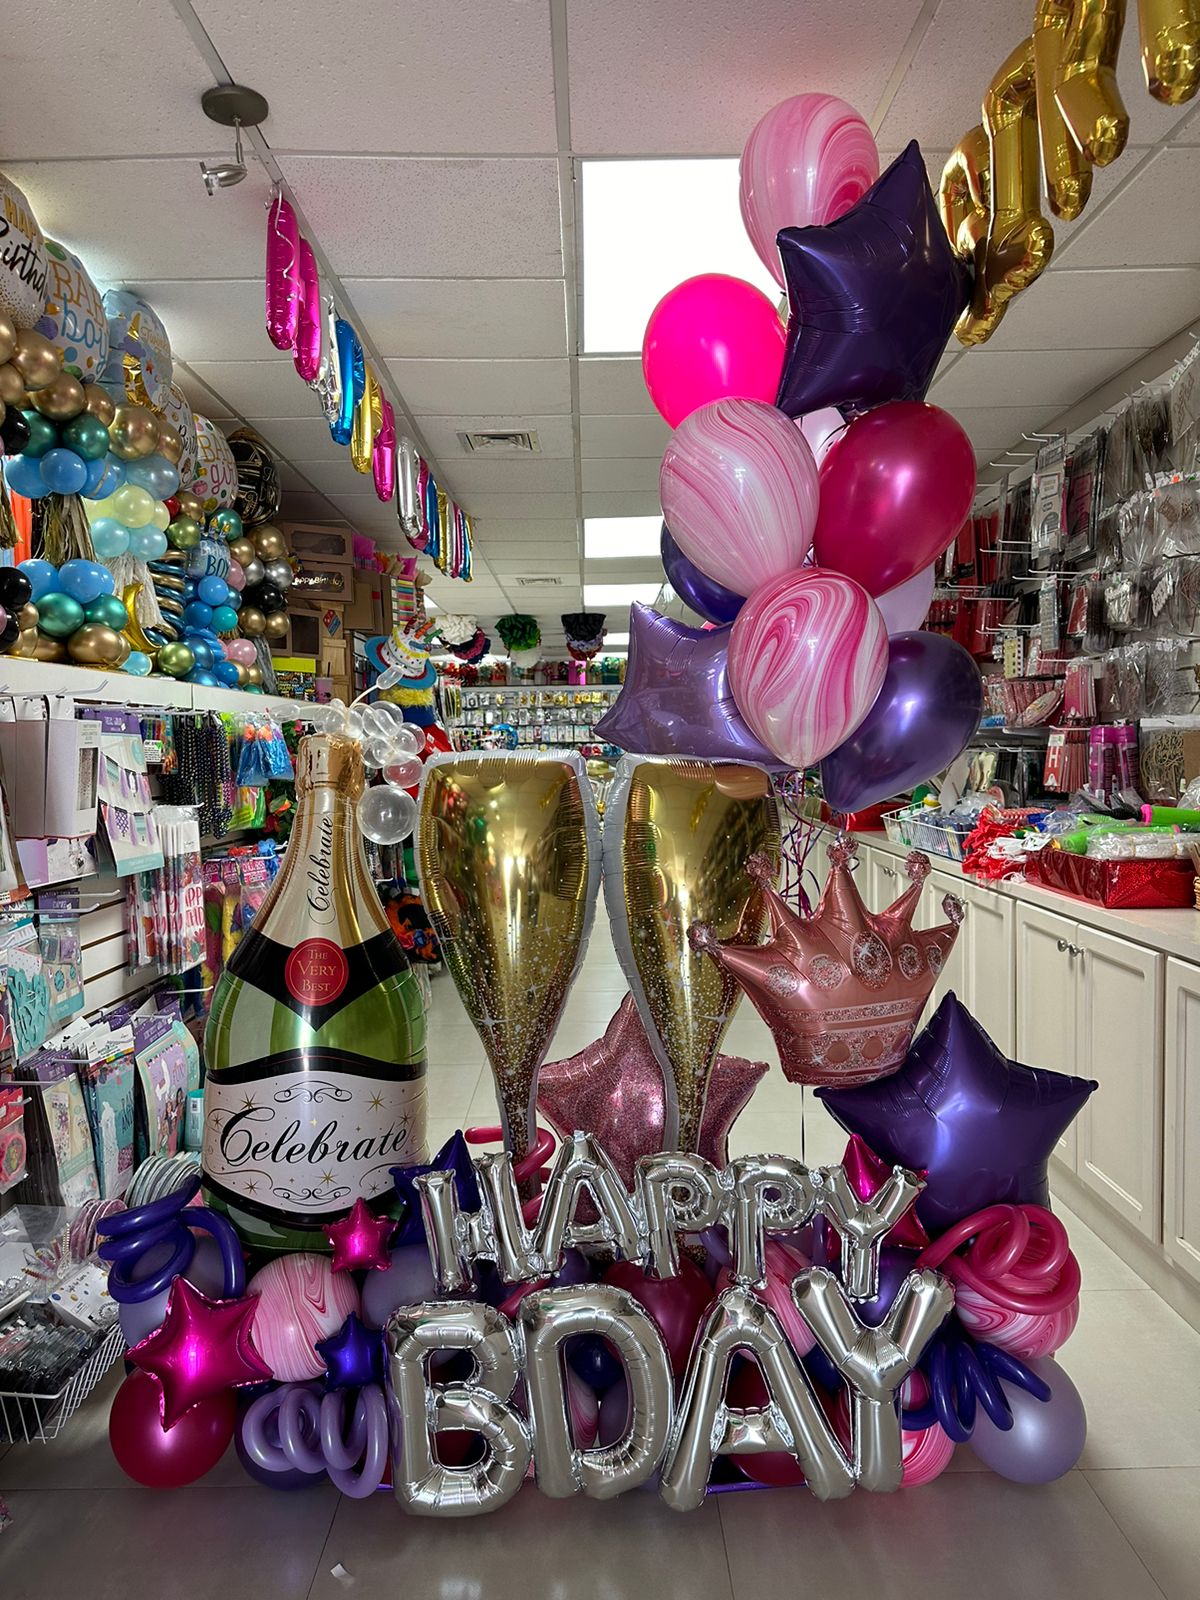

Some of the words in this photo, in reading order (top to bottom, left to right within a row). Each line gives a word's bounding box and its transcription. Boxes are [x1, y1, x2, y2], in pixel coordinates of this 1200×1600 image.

[306, 816, 337, 925] Celebrate
[297, 960, 337, 976] VERY
[302, 979, 331, 992] BEST
[208, 1107, 413, 1168] Celebrate
[413, 1130, 928, 1303] HAPPY
[388, 1266, 956, 1517] BDAY
